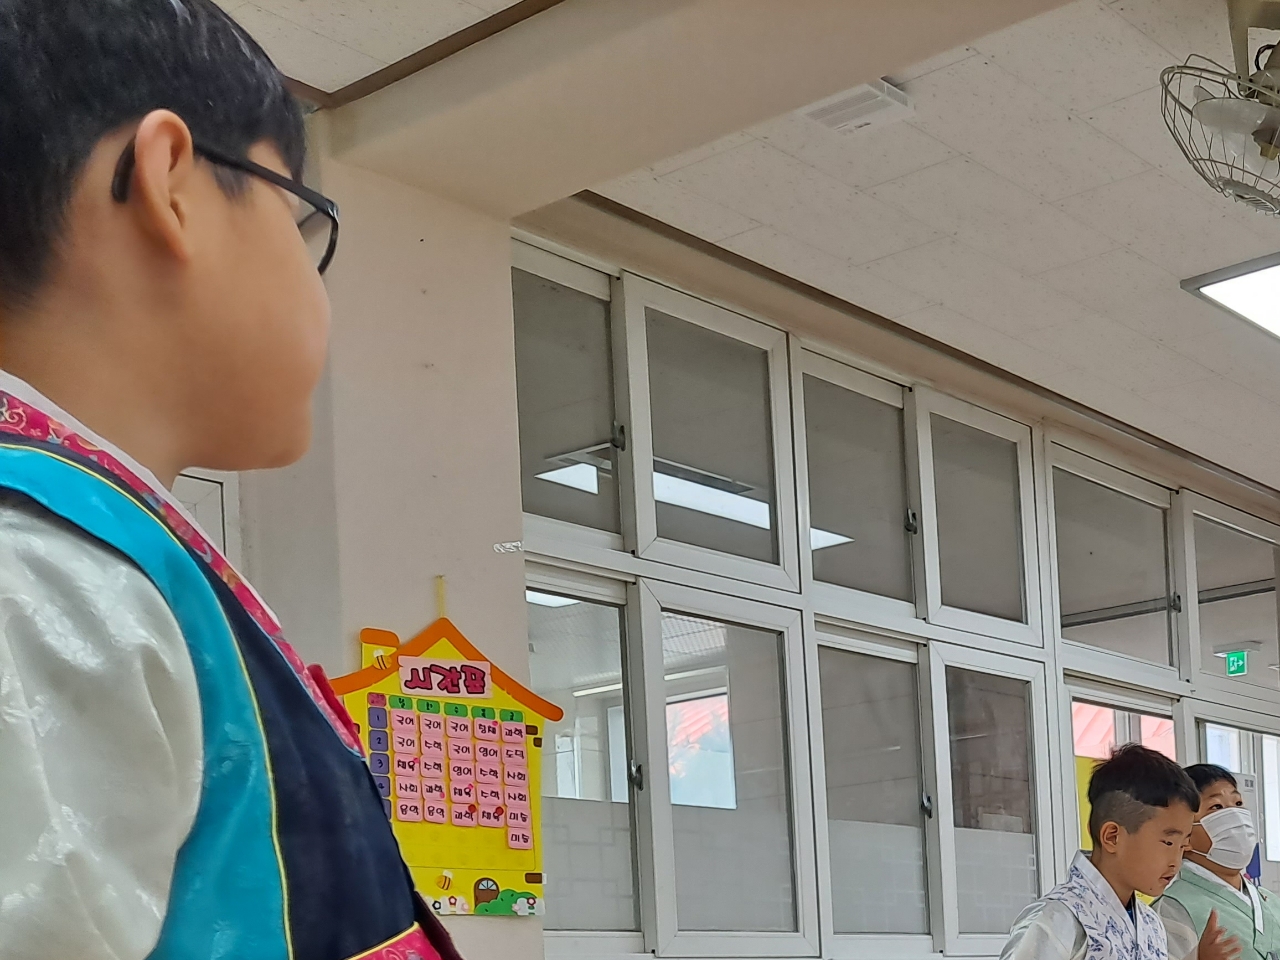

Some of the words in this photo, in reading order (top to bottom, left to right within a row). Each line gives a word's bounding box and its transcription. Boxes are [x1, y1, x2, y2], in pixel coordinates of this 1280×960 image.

[404, 663, 486, 694] 시간표
[396, 714, 415, 725] 국어
[424, 718, 442, 730] 국어
[450, 720, 469, 732] 국어
[396, 735, 415, 748] 국어
[452, 743, 471, 755] 국어
[479, 746, 498, 758] 영어
[452, 766, 472, 776] 영어
[399, 804, 419, 815] 음악
[427, 805, 445, 818] 음악
